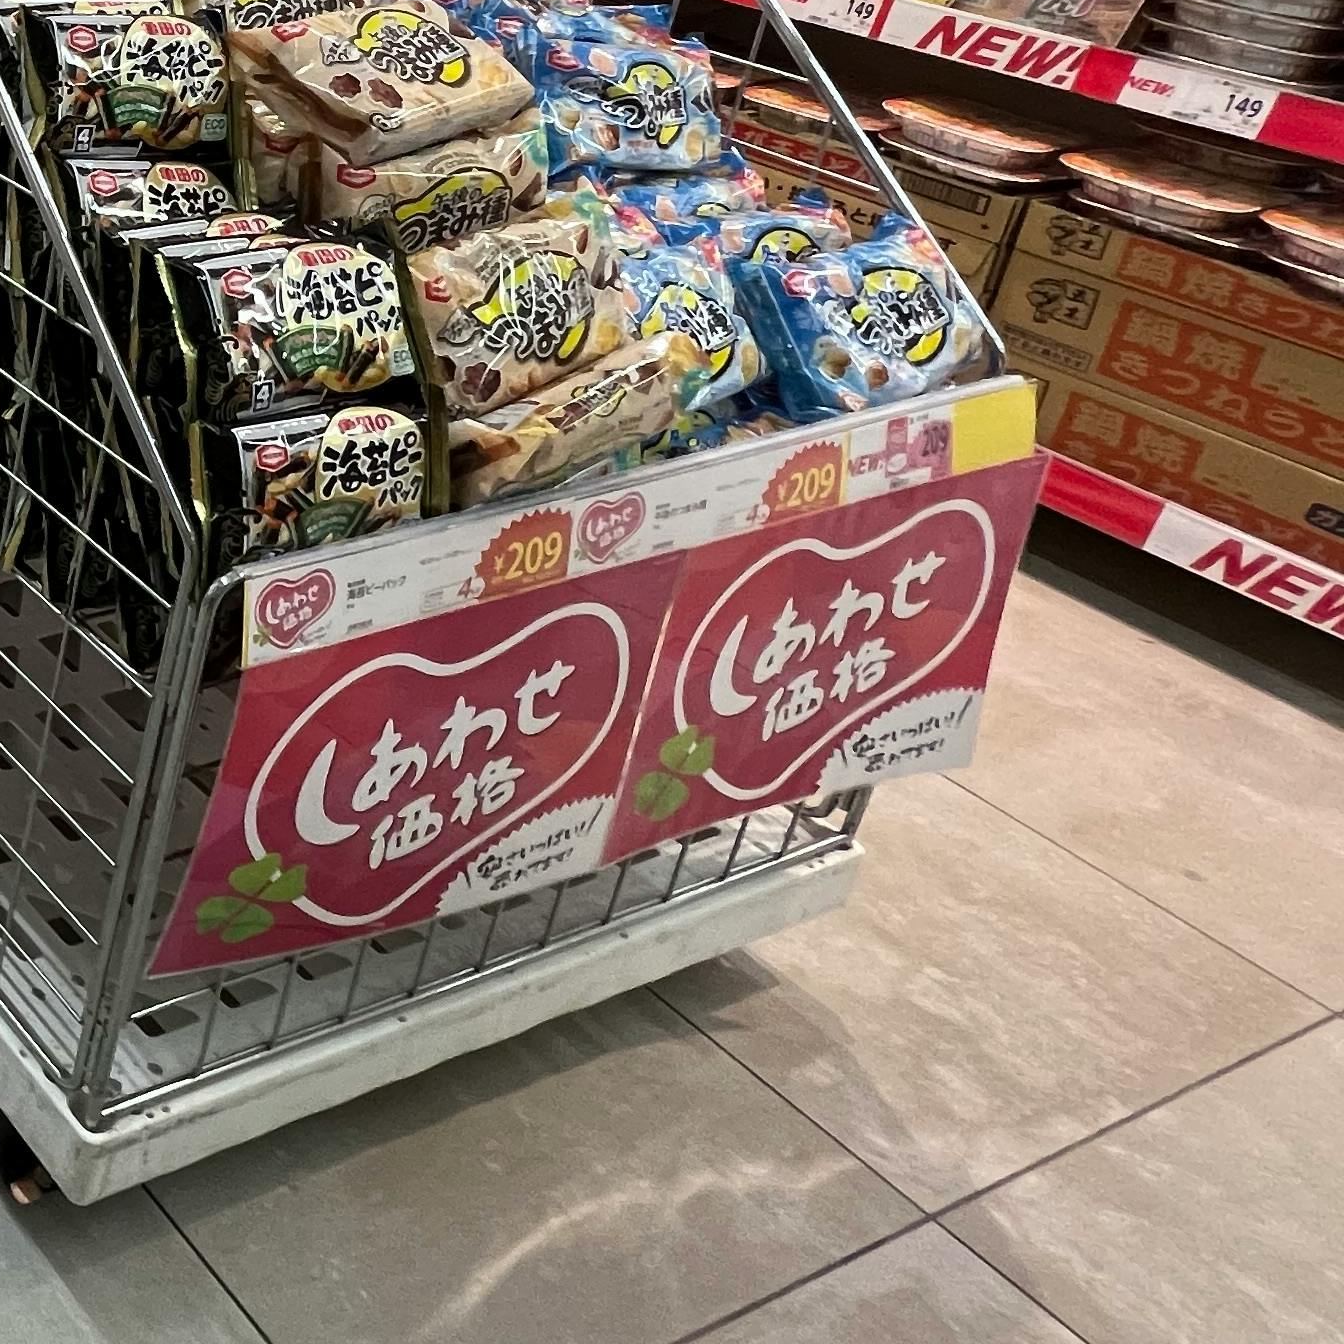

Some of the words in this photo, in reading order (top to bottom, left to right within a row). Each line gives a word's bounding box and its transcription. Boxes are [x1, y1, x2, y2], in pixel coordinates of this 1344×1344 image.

[846, 0, 876, 19] 149
[915, 15, 1083, 86] NEW!
[1223, 92, 1264, 118] 149
[493, 529, 563, 581] ¥209
[710, 551, 948, 717] しあわせ
[762, 637, 897, 742] 価格
[294, 660, 576, 846] しあわせ
[369, 757, 524, 872] 価格
